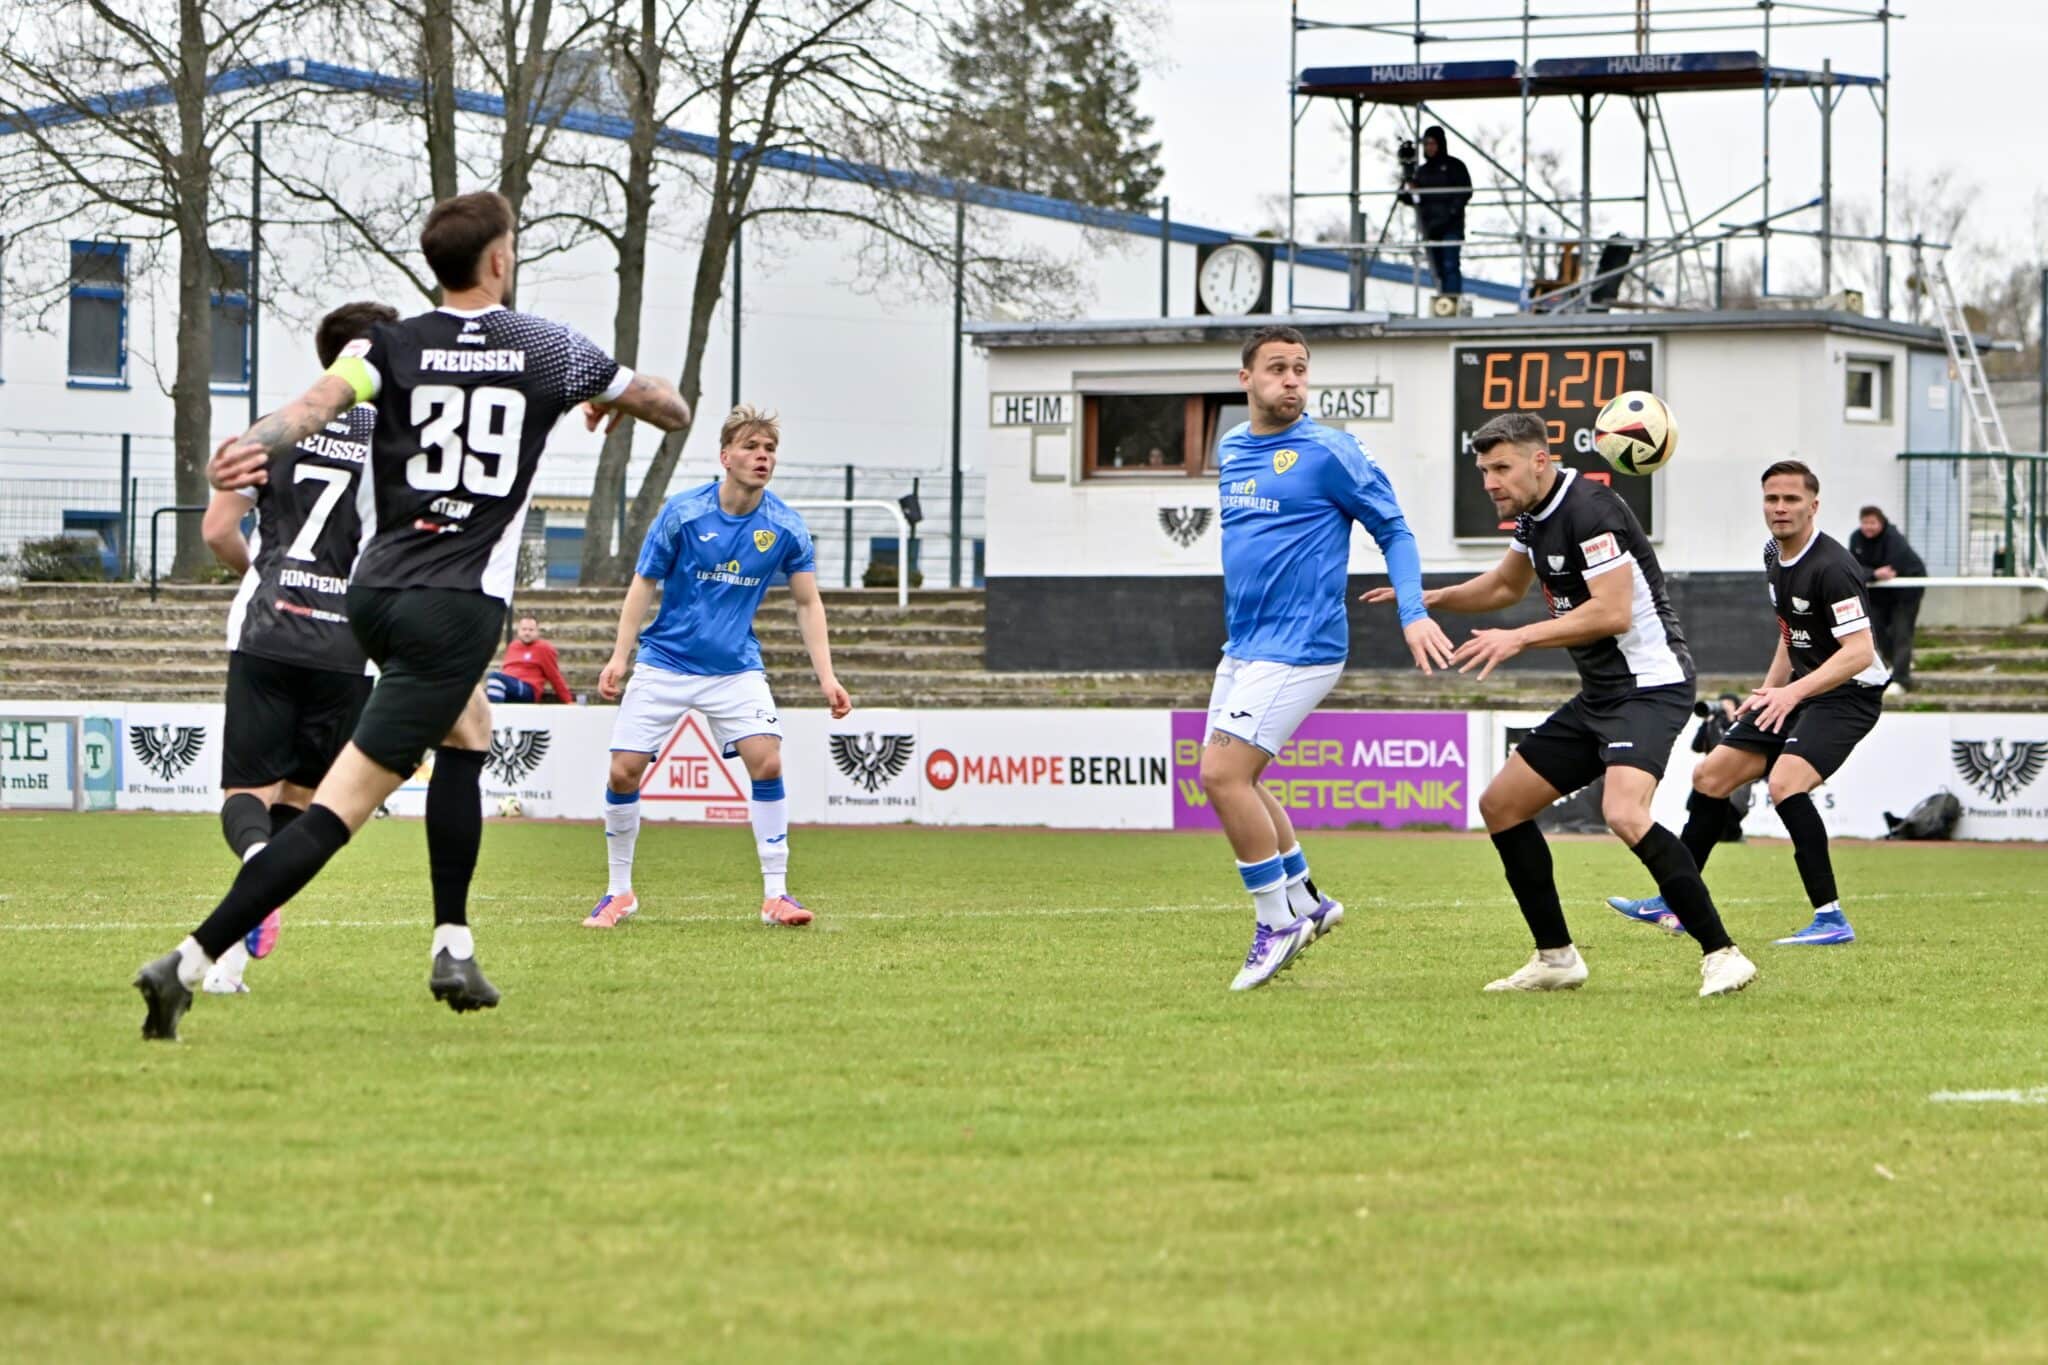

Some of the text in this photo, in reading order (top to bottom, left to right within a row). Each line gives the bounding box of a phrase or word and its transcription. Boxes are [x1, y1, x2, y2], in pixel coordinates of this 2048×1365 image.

[1371, 64, 1444, 82] HAUBITZ
[1607, 55, 1682, 74] HAUBITZ
[420, 349, 525, 372] PREUSSEN
[1005, 396, 1062, 424] HEIM
[1319, 389, 1379, 417] GAST
[406, 385, 527, 497] 39
[286, 463, 352, 562] 7
[85, 744, 104, 769] T
[1175, 740, 1343, 767] BGER
[1352, 740, 1465, 767] MEDIA
[11, 773, 48, 789] mbH
[670, 756, 709, 788] WTG
[962, 756, 1167, 785] MAMPE BERLIN
[1177, 779, 1461, 809] WBETECHNIK
